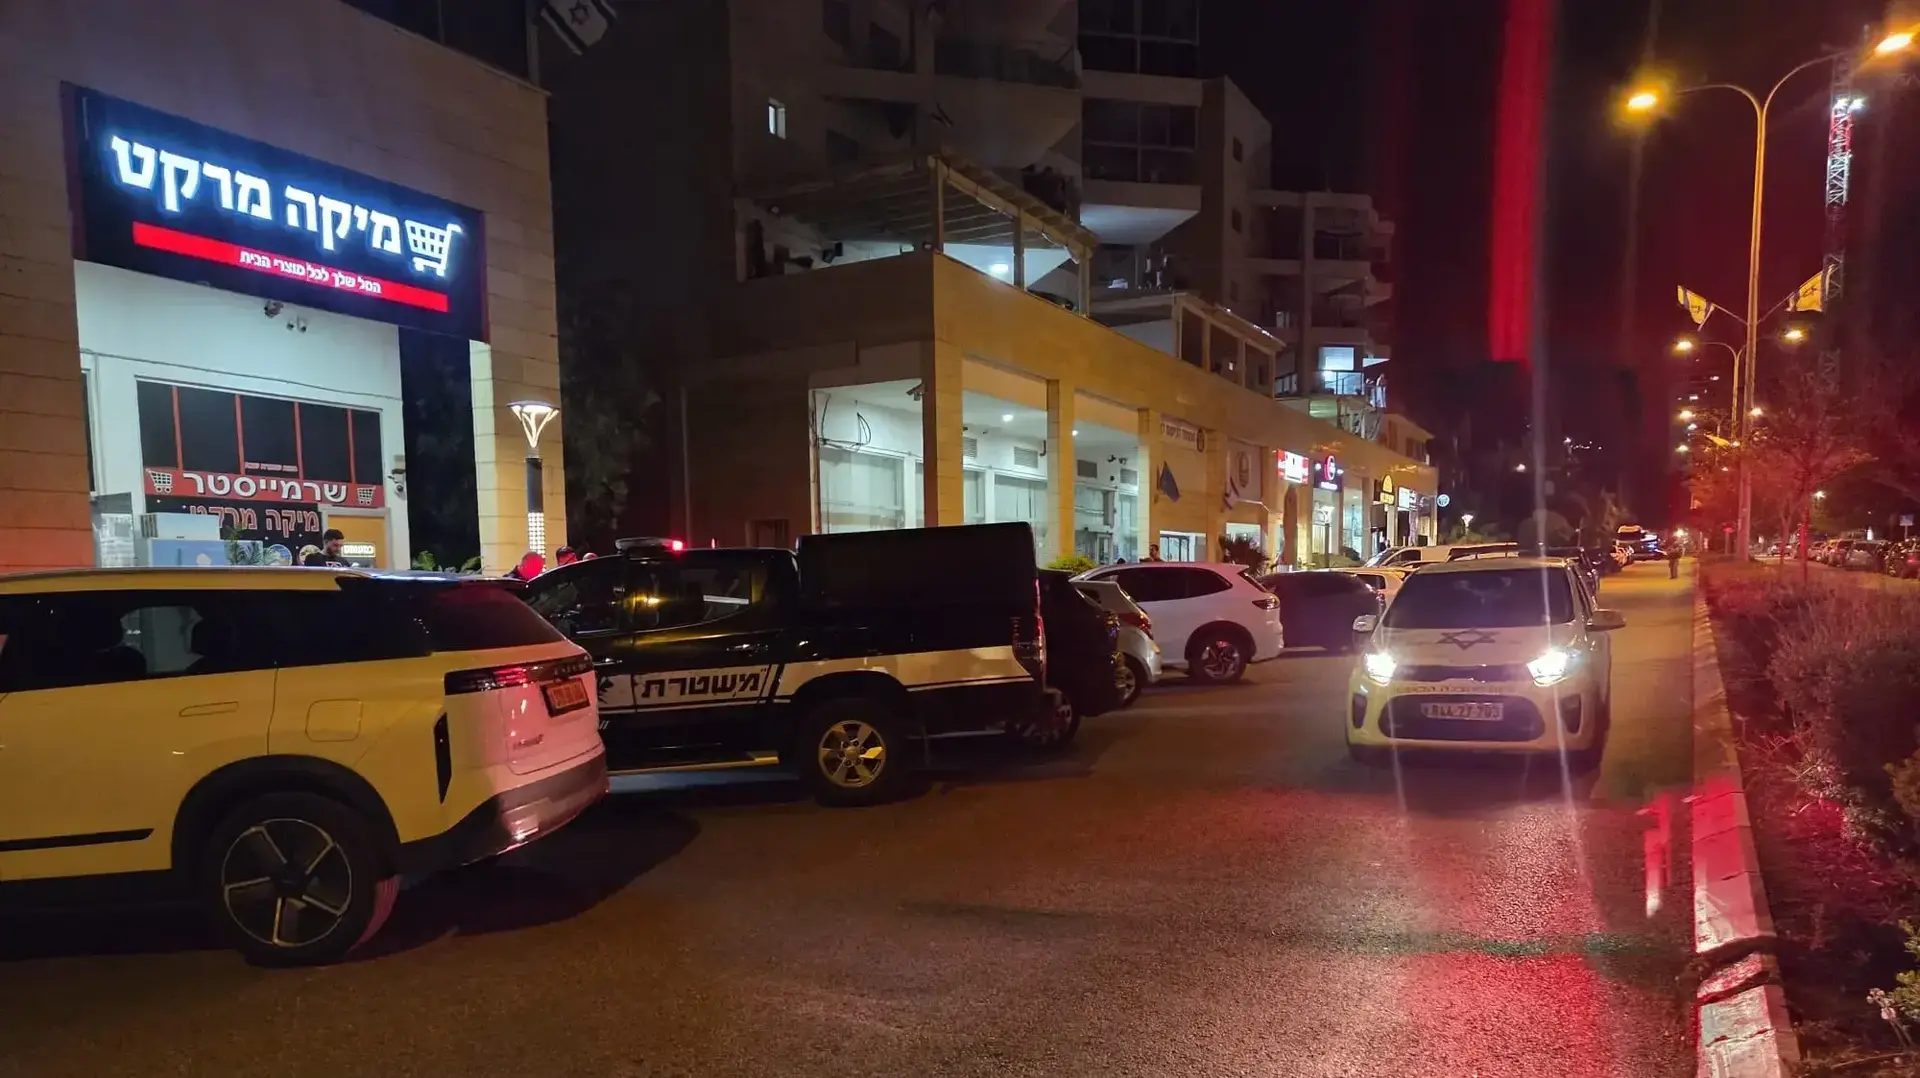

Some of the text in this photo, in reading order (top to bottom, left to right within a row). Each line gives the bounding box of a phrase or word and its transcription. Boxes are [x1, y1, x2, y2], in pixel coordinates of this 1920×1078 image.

[110, 134, 402, 255] מיקה מרקט
[240, 250, 382, 293] הסל שלך לכל מוצרי הבית
[182, 472, 348, 503] שרמייסטר
[265, 508, 320, 539] מיקה
[641, 672, 761, 698] משטרת
